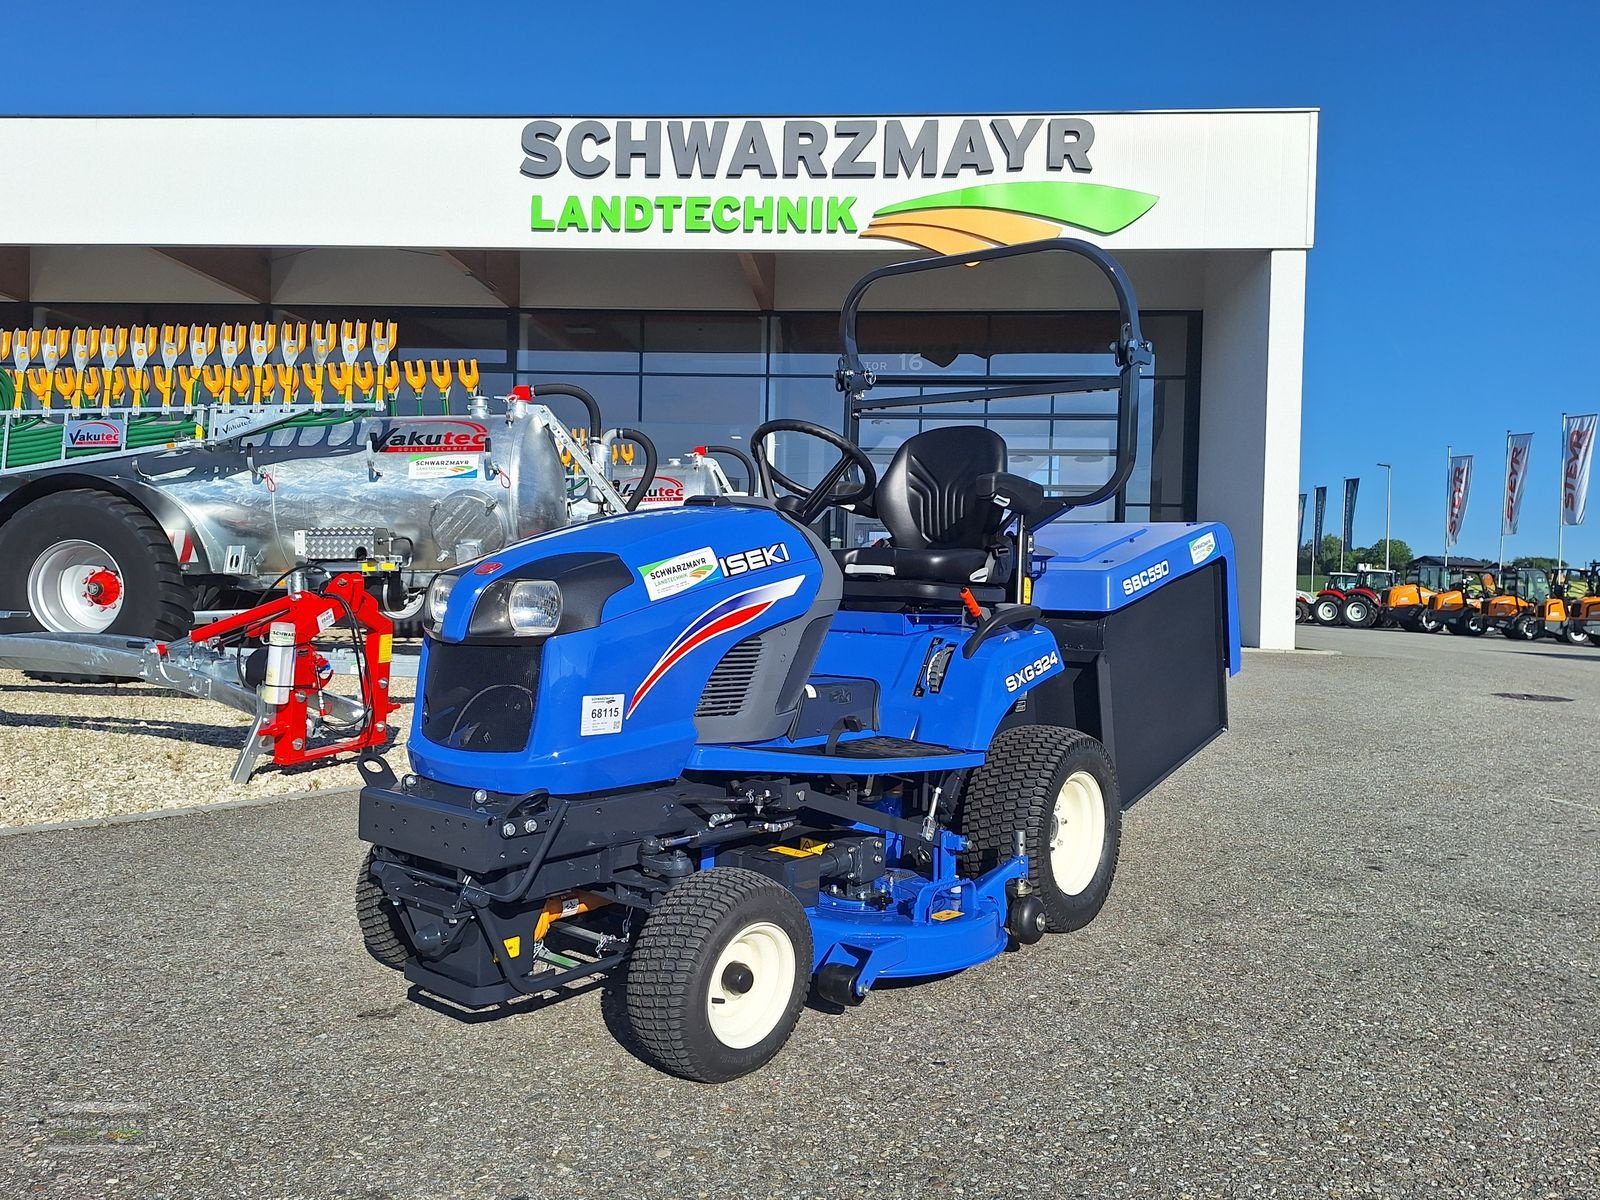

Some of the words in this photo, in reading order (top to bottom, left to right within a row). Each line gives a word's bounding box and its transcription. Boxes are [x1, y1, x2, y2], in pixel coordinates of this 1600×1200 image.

[519, 118, 1095, 179] SCHWARZMAYR
[530, 195, 858, 233] LANDTECHNIK
[864, 361, 887, 370] TOR
[898, 353, 923, 371] 16
[69, 429, 119, 445] Vakutec
[222, 419, 252, 434] Vakutec
[369, 427, 487, 453] Vakutec
[1565, 429, 1590, 511] STEYR
[1507, 447, 1524, 521] STEYR
[650, 557, 707, 580] SCHWARZMAYR
[719, 542, 790, 578] ISEKI
[654, 573, 688, 587] LANDTECHNIK
[1005, 650, 1059, 693] SXG324
[591, 707, 619, 719] 68115
